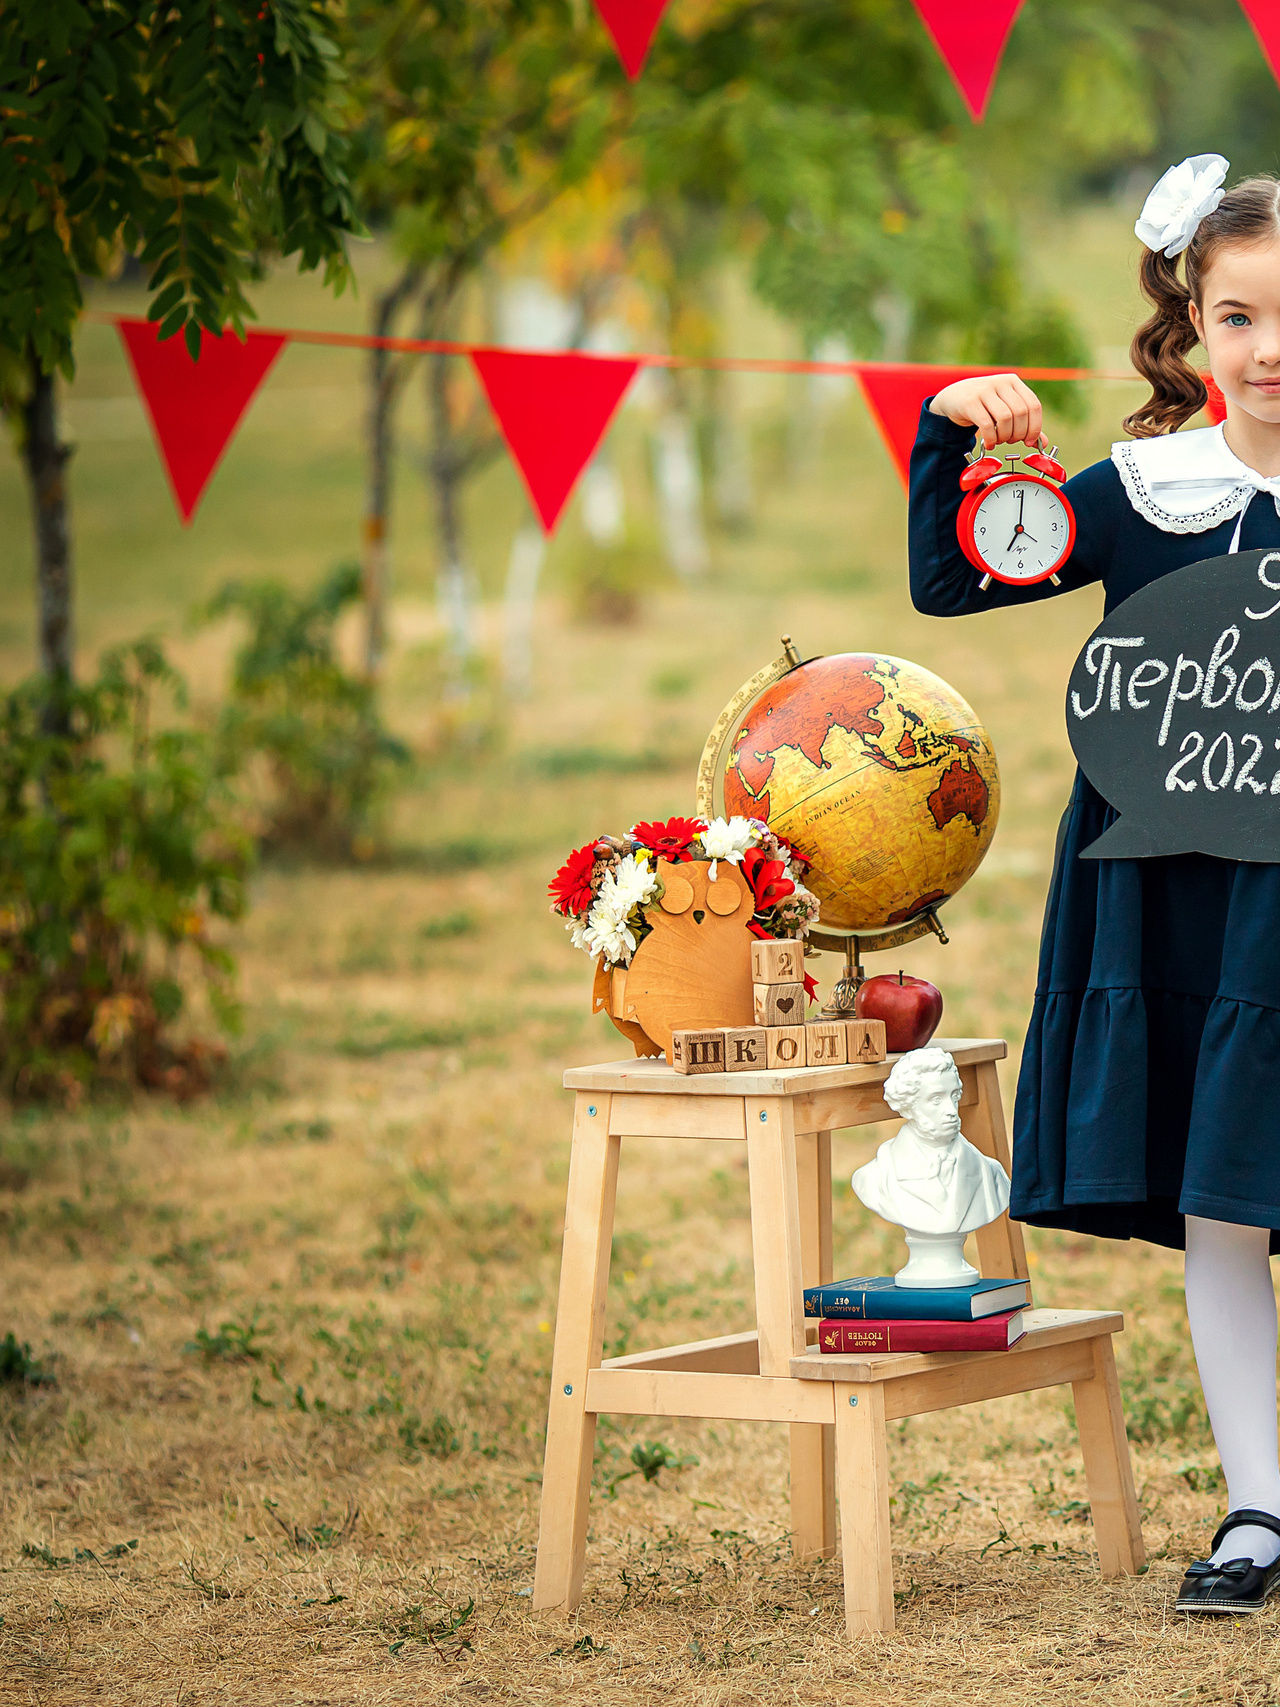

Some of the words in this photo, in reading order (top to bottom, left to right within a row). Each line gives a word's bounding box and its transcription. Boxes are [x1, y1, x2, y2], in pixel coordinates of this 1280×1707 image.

[1012, 489, 1023, 499] 12
[979, 527, 987, 536] 9
[1051, 522, 1058, 532] 3
[1017, 559, 1024, 569] 6
[805, 806, 832, 826] INDIAN
[834, 789, 861, 809] OCEAN
[688, 1033, 879, 1065] ШКОЛА
[834, 1297, 850, 1305] ФЕТ
[847, 1332, 884, 1340] ТЮТЧЕВ
